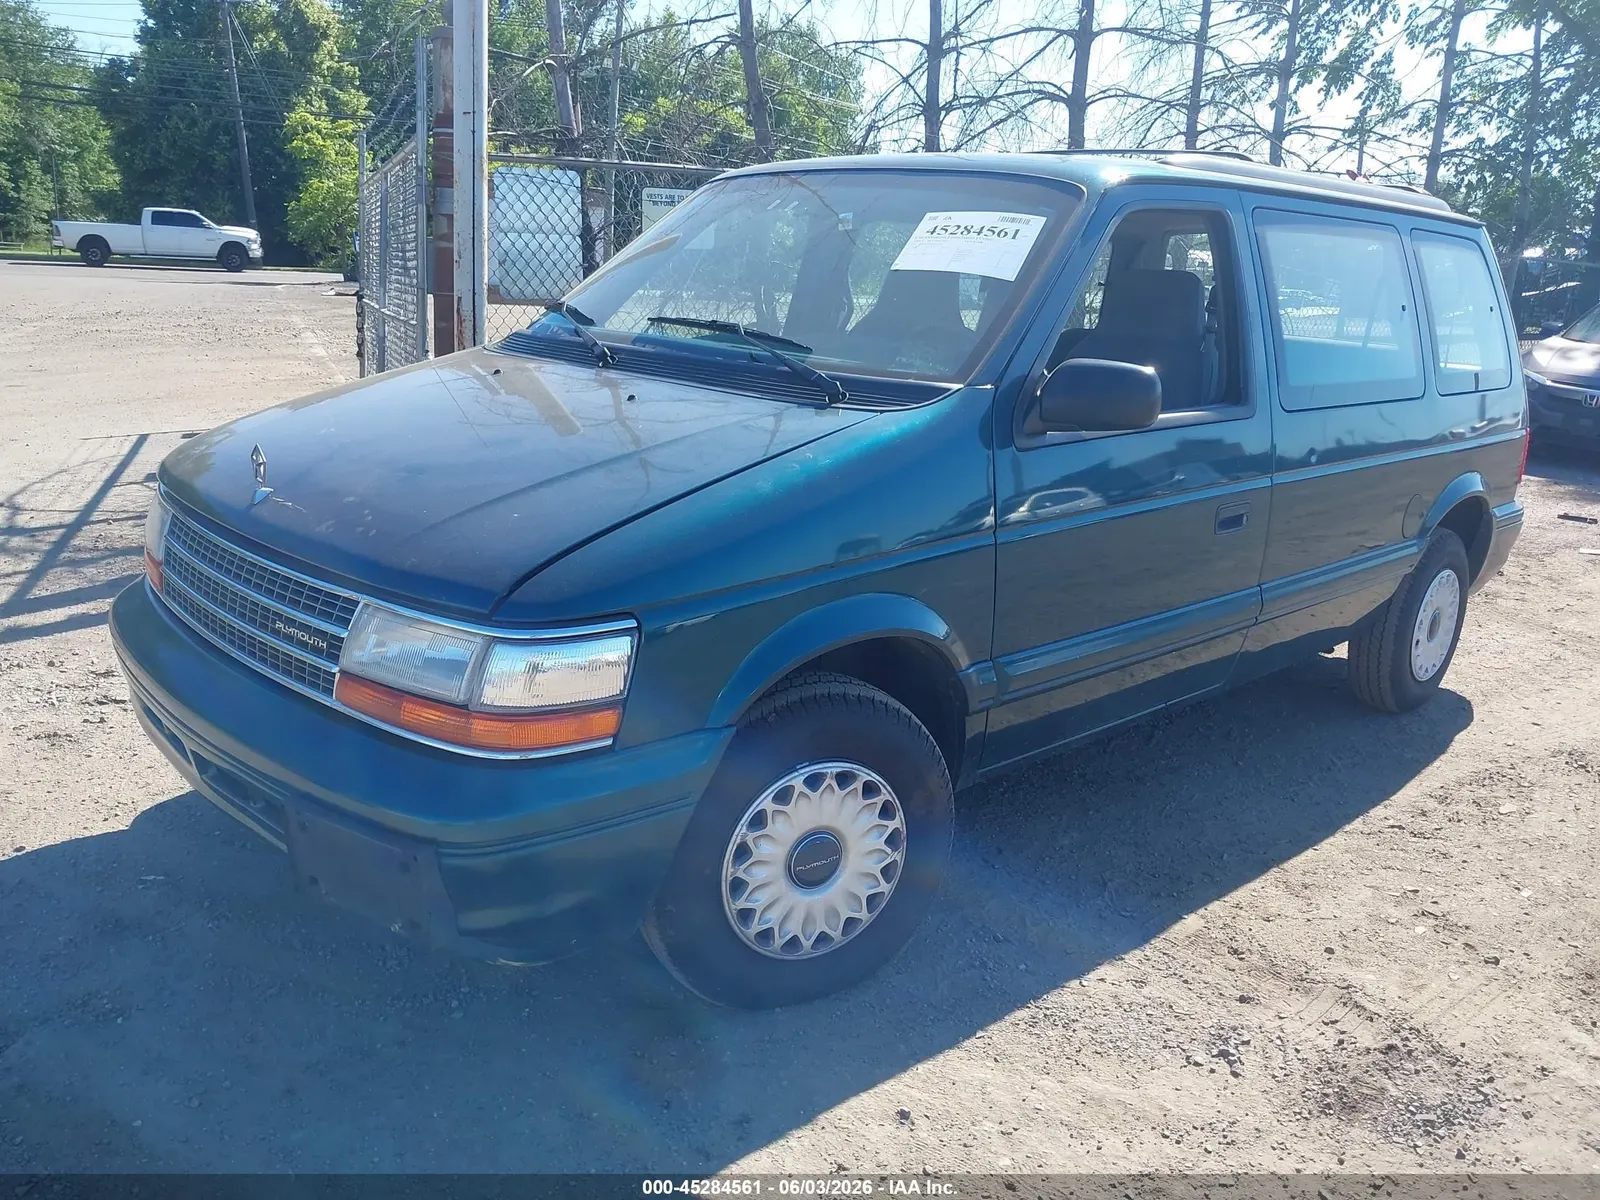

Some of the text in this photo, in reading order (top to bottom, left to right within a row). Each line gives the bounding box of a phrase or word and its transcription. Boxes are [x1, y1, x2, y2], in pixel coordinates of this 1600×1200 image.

[926, 224, 1021, 240] 45284561
[275, 620, 327, 649] PLYMOUTH
[796, 854, 839, 872] PLYMOUTH
